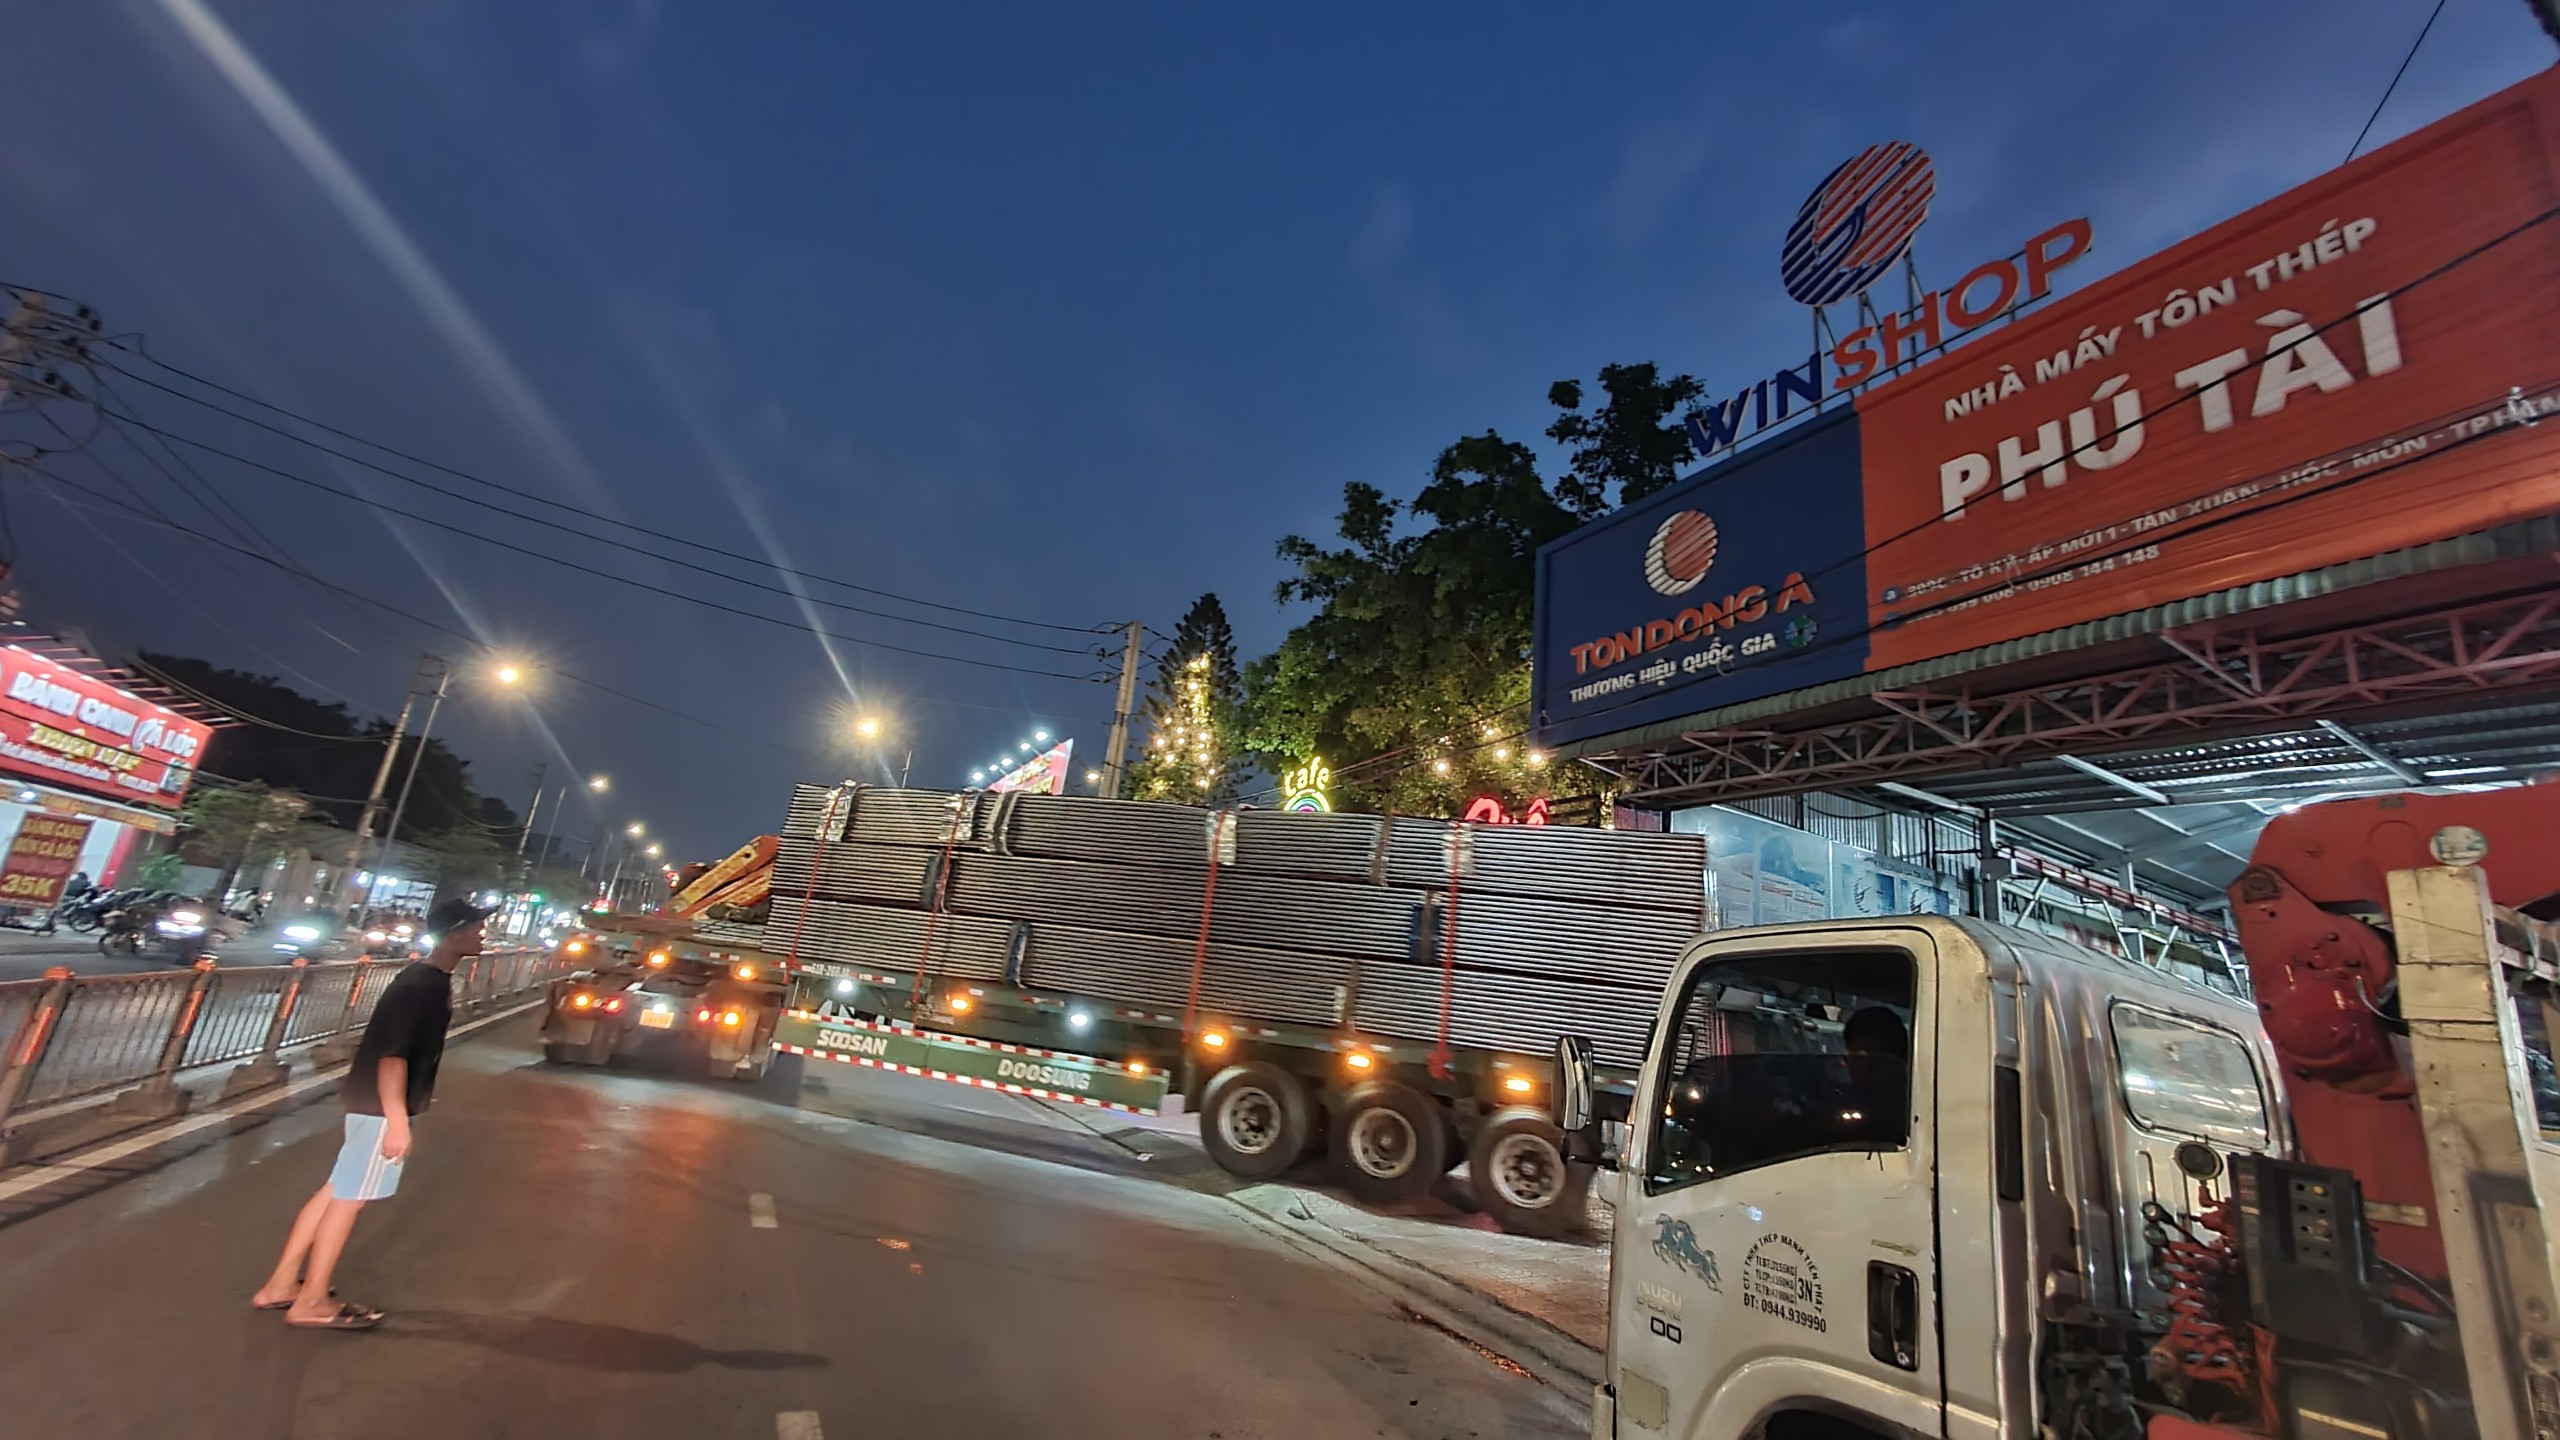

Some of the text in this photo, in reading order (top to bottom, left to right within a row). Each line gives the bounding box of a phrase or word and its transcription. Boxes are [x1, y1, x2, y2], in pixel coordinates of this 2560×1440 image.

[1944, 217, 2377, 422] NHÀ MÁY TÔN THÉP
[1939, 292, 2402, 522] PHÚ TÀI
[2130, 508, 2177, 532] TÂN
[2279, 460, 2340, 490] HÓC
[2352, 435, 2427, 469] MÔN
[2079, 558, 2116, 577] 144
[2121, 544, 2160, 564] 148
[1775, 572, 1815, 613] A
[1569, 632, 1777, 703] THƯƠNG HIỆU QUỐC GIA
[1, 873, 58, 897] 35K
[817, 1029, 888, 1056] SOOSAN
[997, 1058, 1091, 1090] DOOSUNG
[1798, 1277, 1813, 1303] 3N
[1761, 1299, 1827, 1333] 0944.939990
